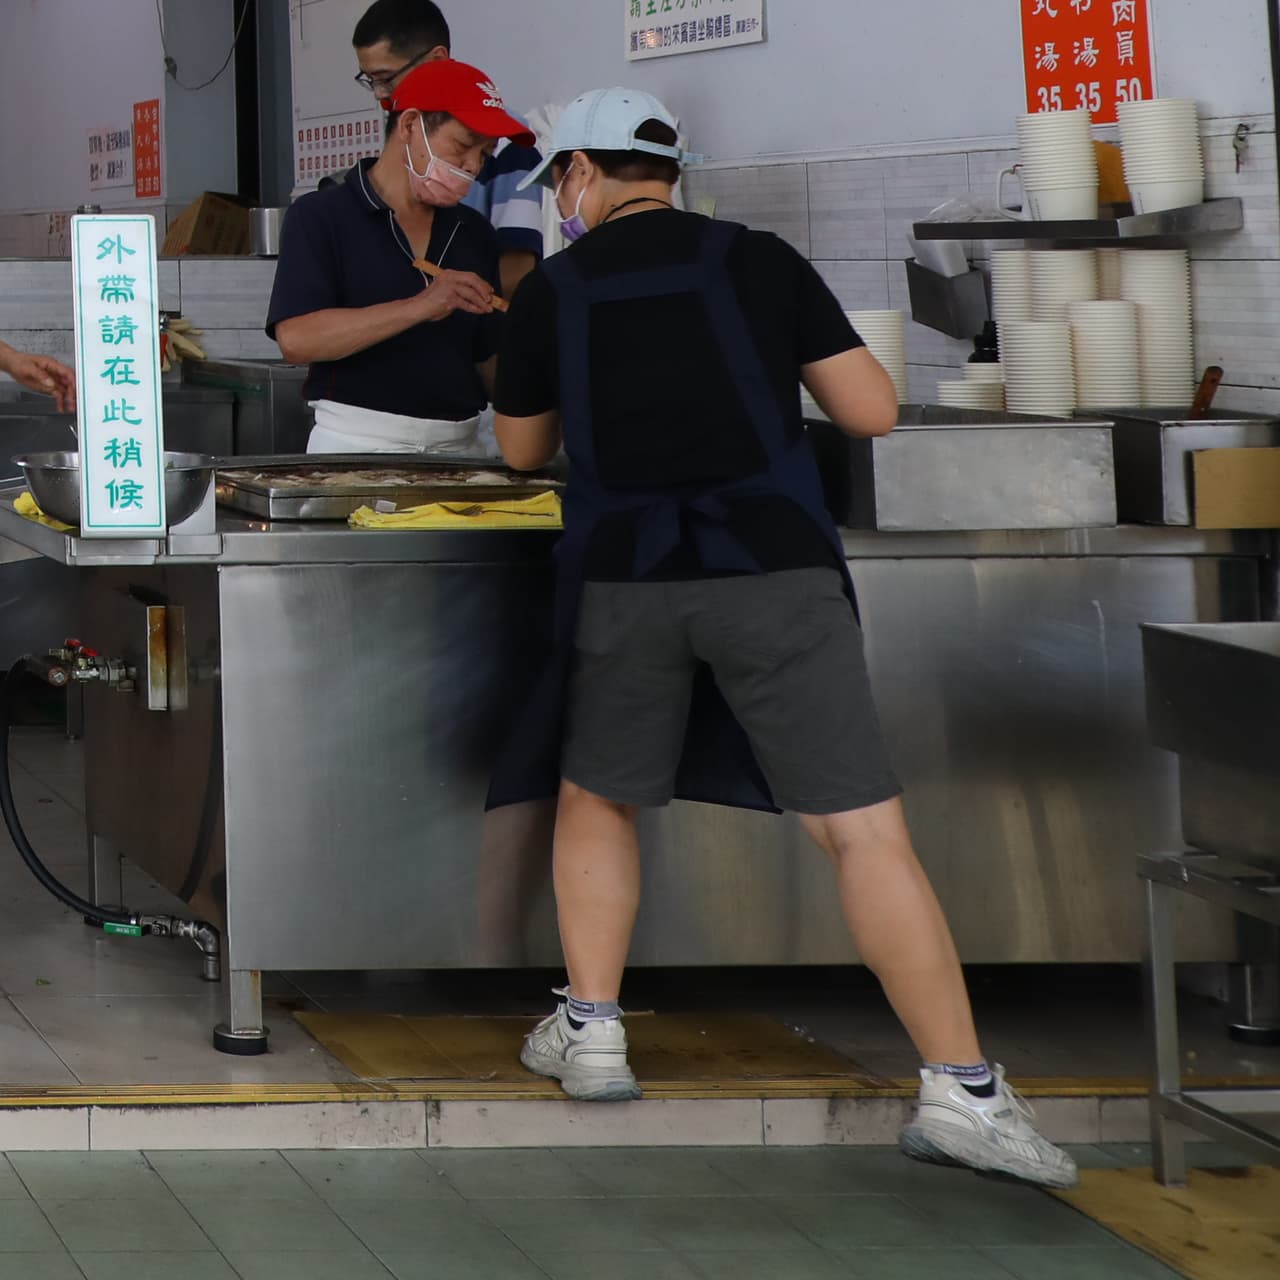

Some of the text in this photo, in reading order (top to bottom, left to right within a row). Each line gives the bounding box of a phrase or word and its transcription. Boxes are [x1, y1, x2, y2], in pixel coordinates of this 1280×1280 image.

[1037, 85, 1062, 113] 35
[1075, 81, 1102, 113] 35
[1115, 77, 1142, 103] 50
[96, 233, 144, 510] 外帶請在此稍候
